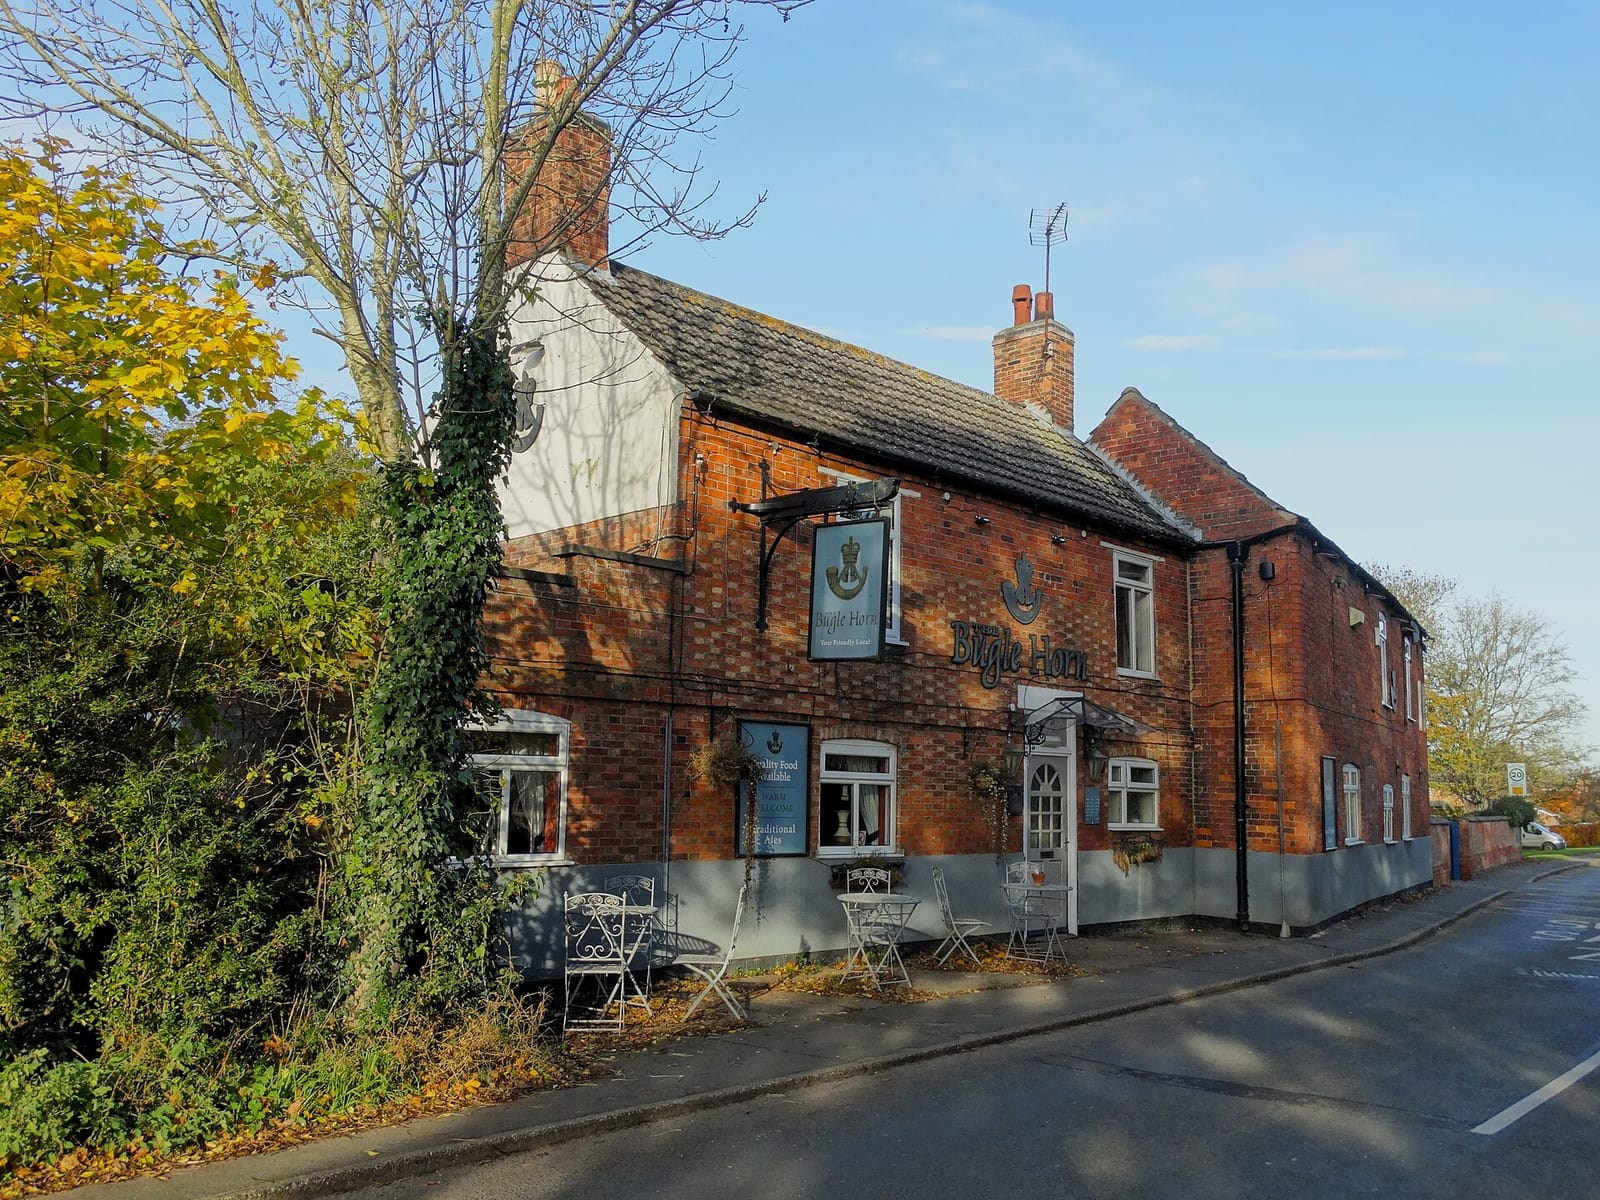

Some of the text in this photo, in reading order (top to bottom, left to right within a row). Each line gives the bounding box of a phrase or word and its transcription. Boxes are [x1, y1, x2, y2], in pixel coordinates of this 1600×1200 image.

[816, 611, 878, 635] Bugle Horn
[833, 639, 855, 648] Friendly
[855, 637, 871, 645] Local
[950, 620, 1089, 689] Bugle Horn
[756, 758, 799, 772] uality Food
[761, 792, 786, 801] WARM
[759, 803, 793, 813] ELCOME
[756, 823, 796, 834] raditional
[764, 834, 782, 845] Ales
